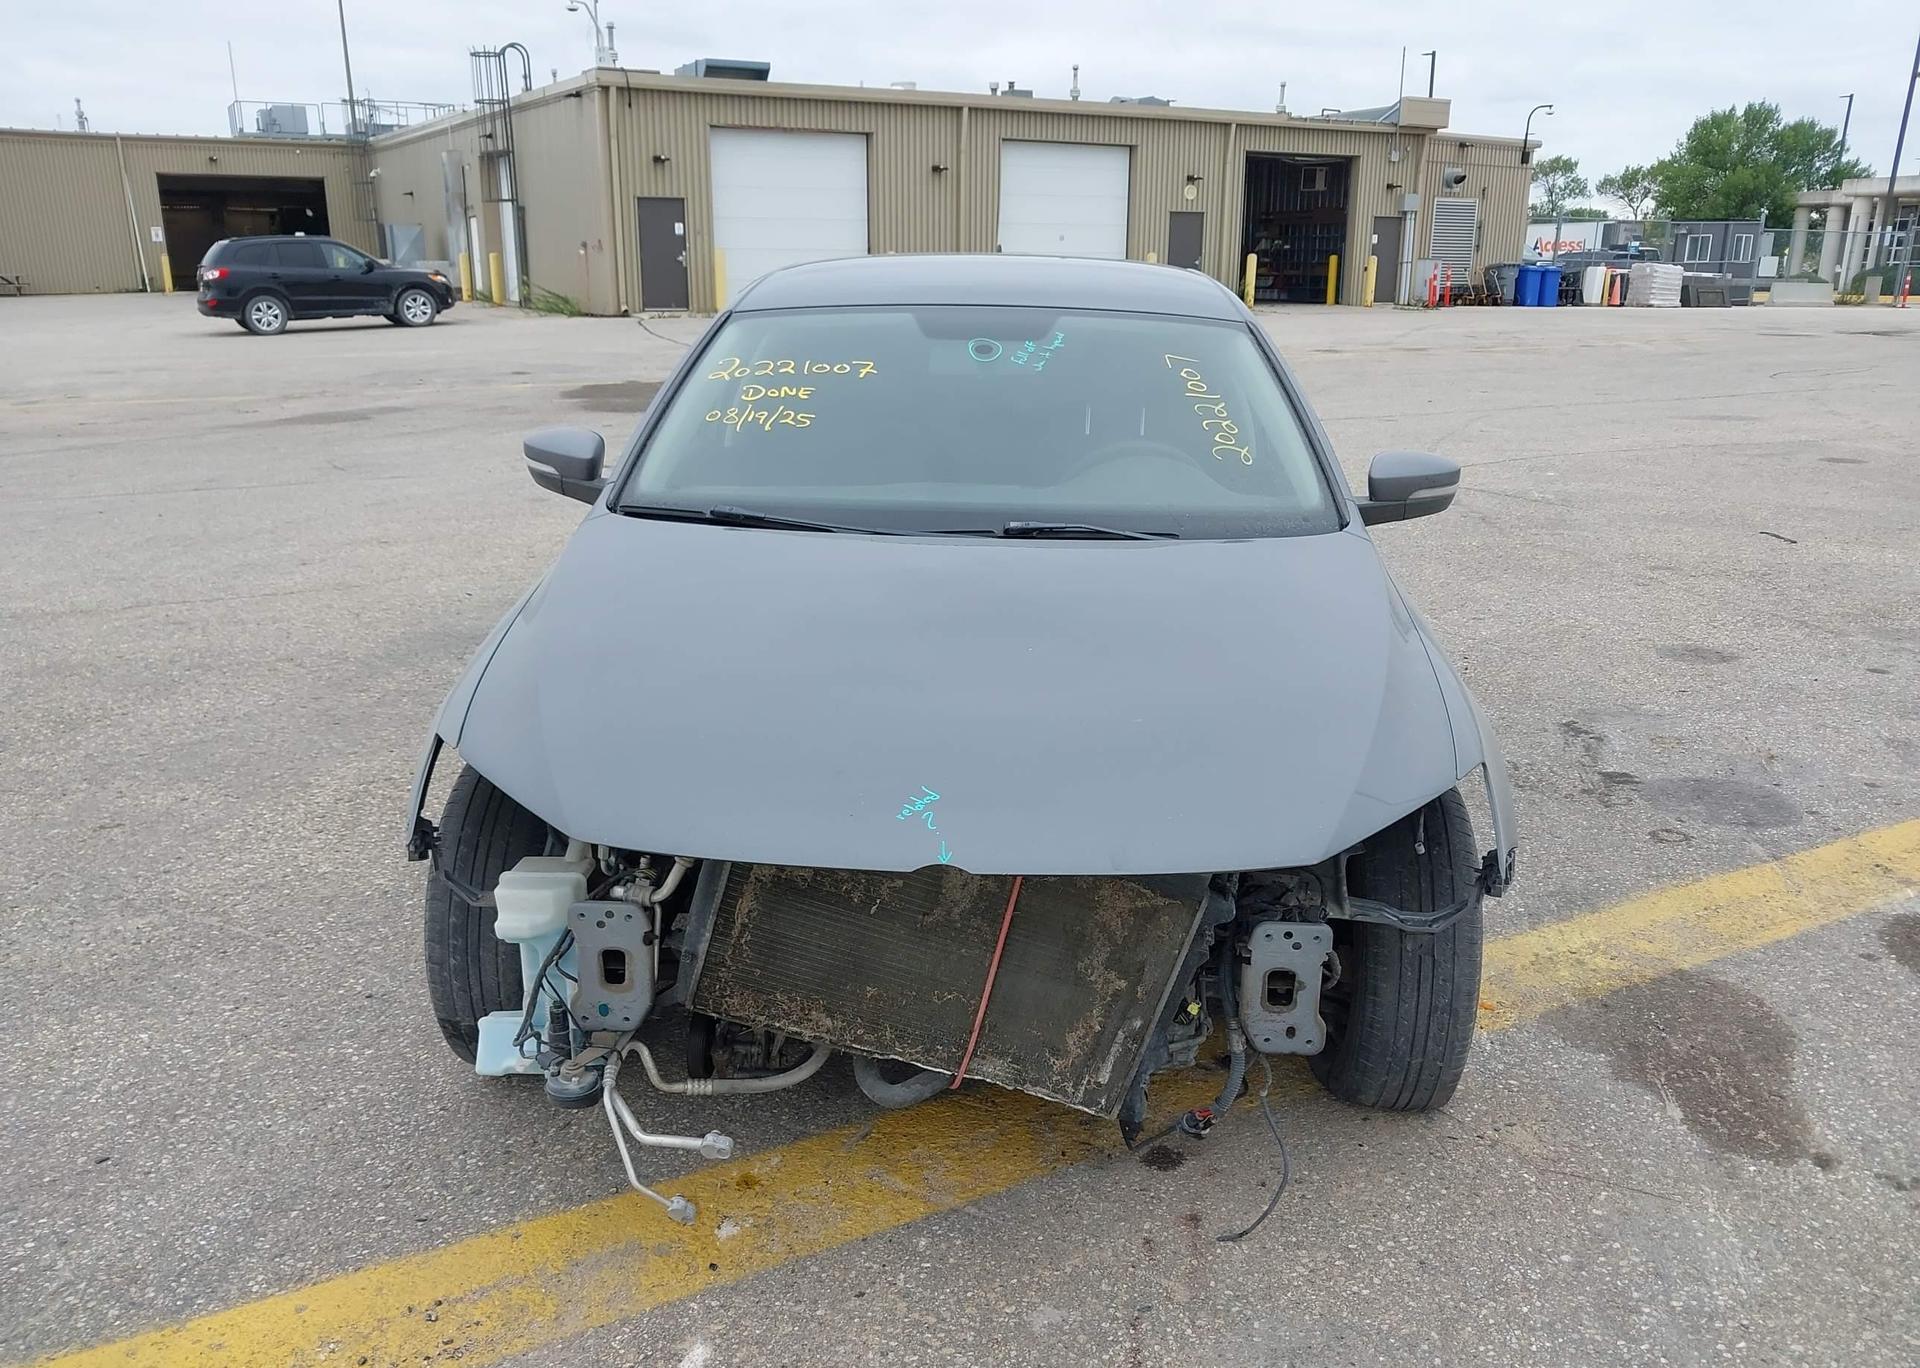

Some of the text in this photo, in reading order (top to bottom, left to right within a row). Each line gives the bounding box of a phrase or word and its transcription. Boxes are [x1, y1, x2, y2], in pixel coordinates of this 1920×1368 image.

[707, 357, 878, 381] 20221007
[705, 404, 816, 432] 08/19/25
[1164, 353, 1253, 466] 20221007
